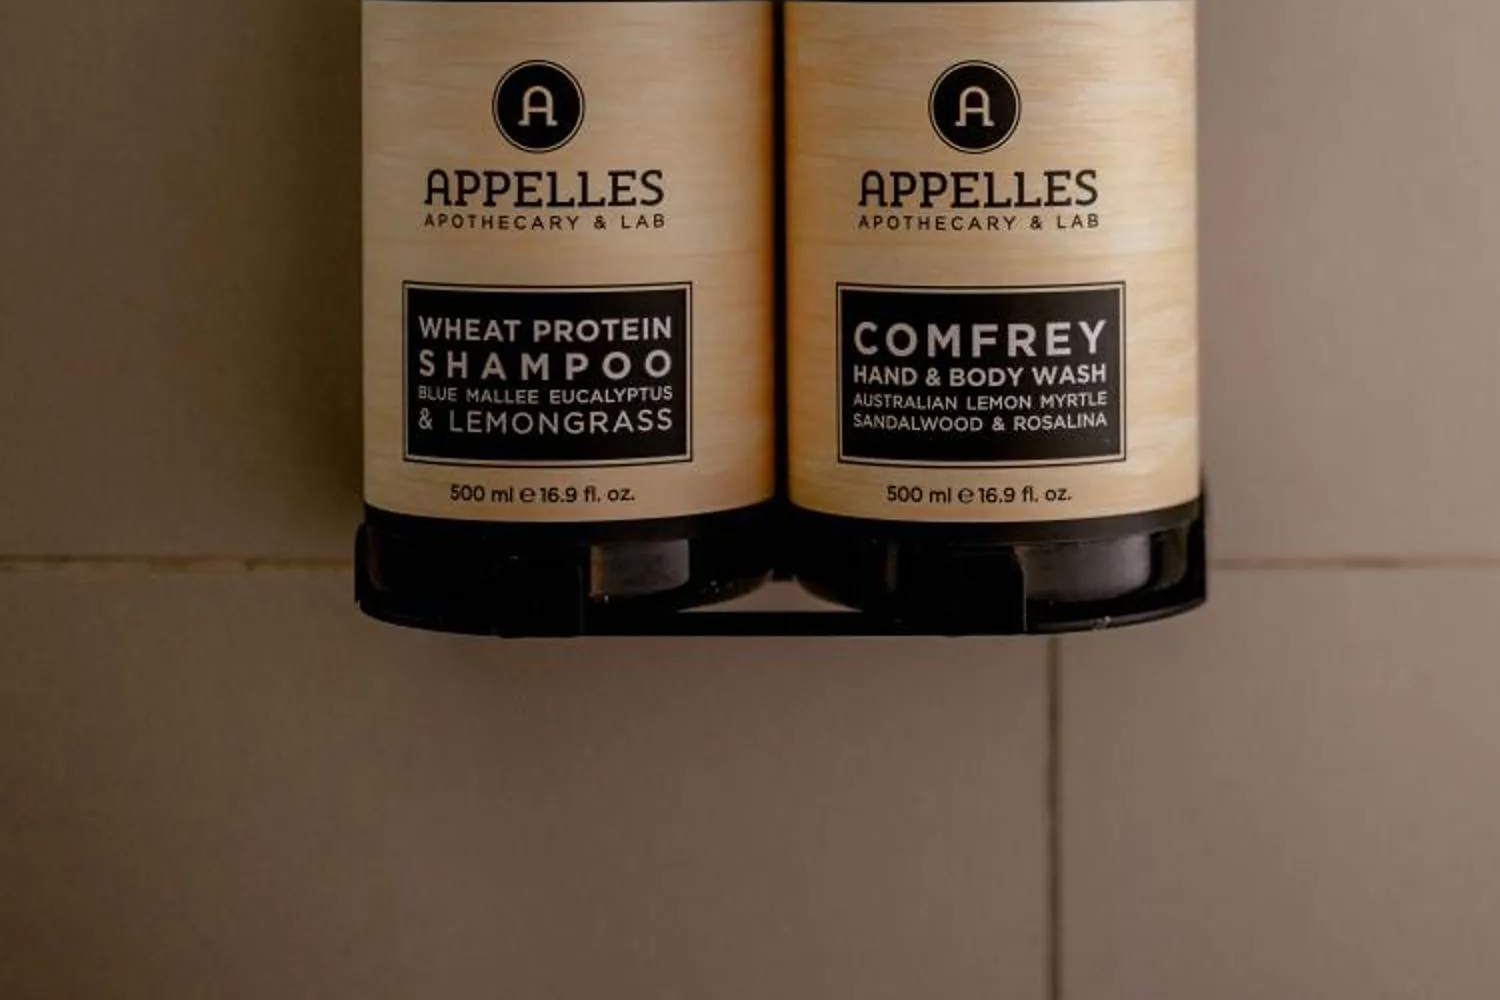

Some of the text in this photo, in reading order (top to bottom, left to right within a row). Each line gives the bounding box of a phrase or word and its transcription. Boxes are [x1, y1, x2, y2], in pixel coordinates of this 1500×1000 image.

[518, 86, 557, 126] A
[955, 86, 994, 126] A
[424, 169, 664, 206] APPELLES
[858, 169, 1098, 208] APPELLES
[423, 213, 664, 231] APOTHECARY & LAB
[858, 213, 1099, 231] APOTHECARY & LAB
[419, 316, 671, 342] WHEAT PROTEIN
[854, 319, 1107, 357] COMFREY
[420, 349, 672, 380] SHAMPOO
[854, 363, 1106, 387] HAND & BODY WASH
[419, 385, 672, 404] BLUE MALLEE EUCALYPTUS
[854, 390, 1108, 410] AUSTRALIAN LEMON MYRTLE
[418, 408, 672, 434] & LEMONGRASS
[854, 411, 1108, 432] SANDALWOOD & ROSALINA
[450, 483, 485, 502] 500
[491, 486, 514, 503] ml
[583, 486, 601, 502] fl.
[607, 488, 635, 502] oz.
[887, 485, 923, 503] 500
[929, 488, 952, 503] ml
[1022, 486, 1038, 502] fl.
[1043, 488, 1071, 502] oz.
